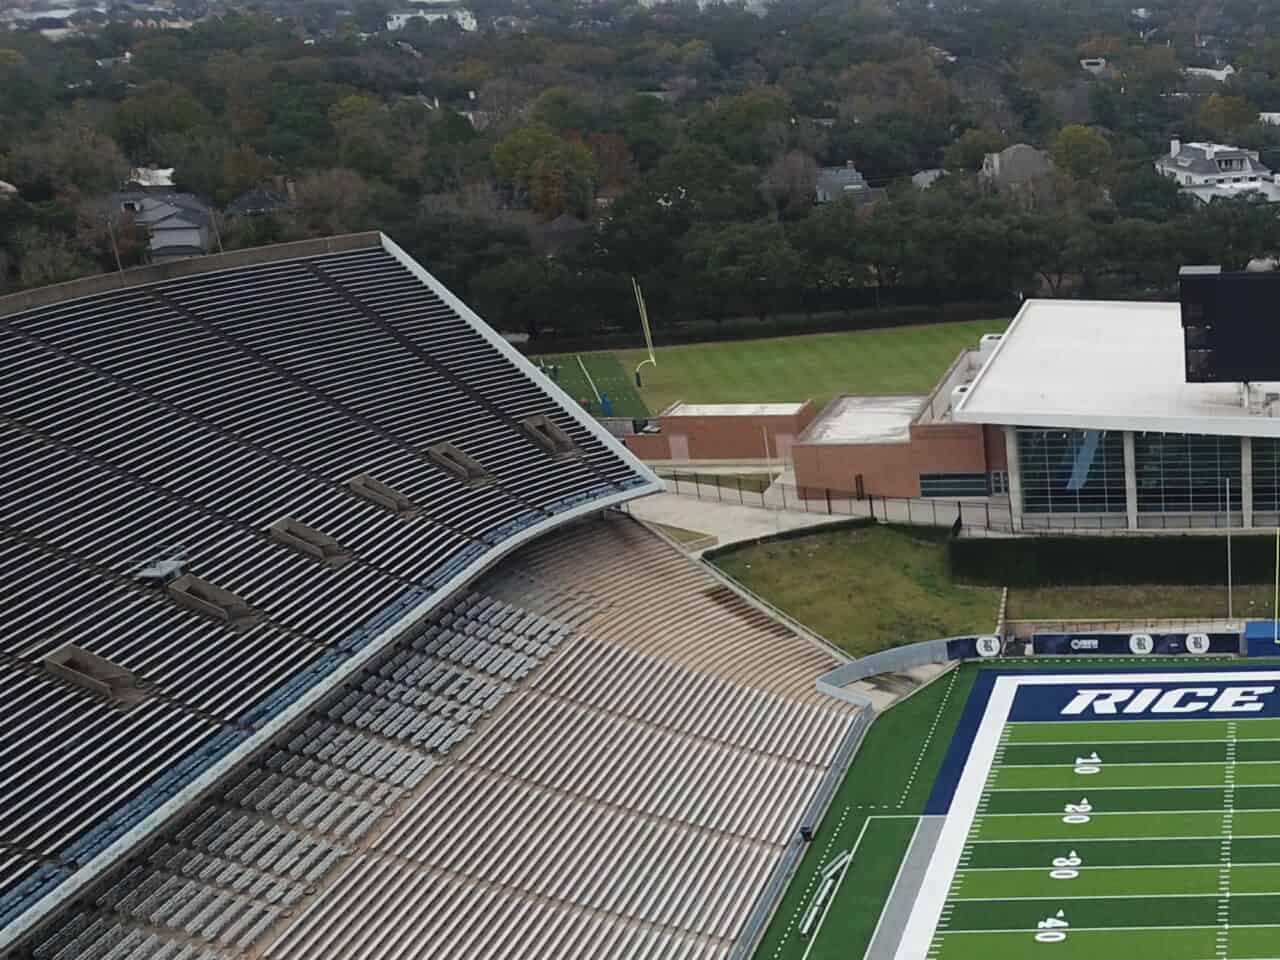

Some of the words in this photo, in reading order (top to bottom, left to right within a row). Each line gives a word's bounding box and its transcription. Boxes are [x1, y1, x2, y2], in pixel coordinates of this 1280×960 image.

[1061, 687, 1275, 714] RICE
[1075, 756, 1101, 774] 10
[1049, 857, 1082, 879] 30
[1036, 916, 1069, 942] 40
